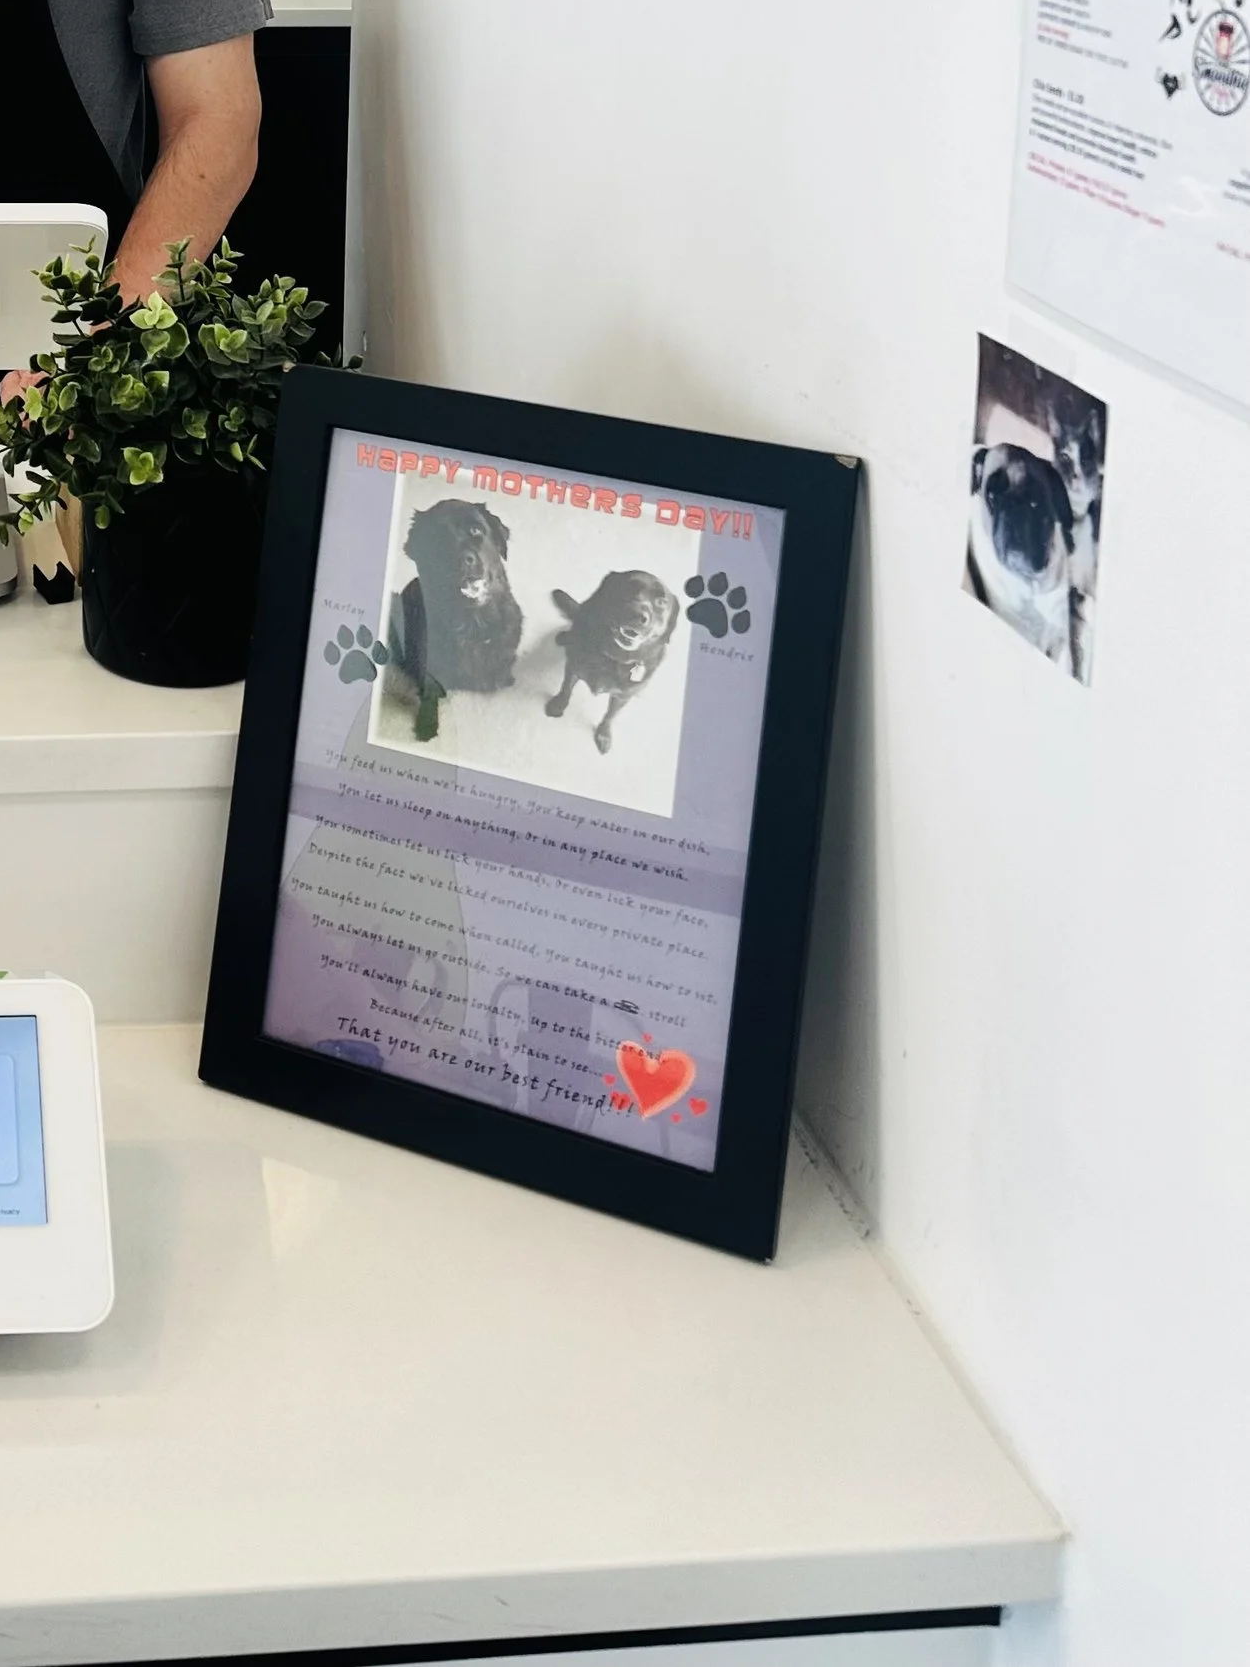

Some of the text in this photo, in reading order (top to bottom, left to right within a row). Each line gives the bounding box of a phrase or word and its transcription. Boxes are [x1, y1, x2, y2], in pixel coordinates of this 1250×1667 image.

[365, 790, 382, 803] let
[385, 797, 400, 808] us
[403, 800, 432, 820] sleep
[436, 810, 451, 822] on
[525, 831, 542, 844] Or
[542, 835, 556, 847] in
[560, 841, 587, 860] any
[591, 848, 629, 869] place
[632, 860, 649, 872] we
[654, 862, 689, 883] wish.
[337, 1016, 382, 1043] That
[388, 1034, 421, 1057] you
[428, 1049, 457, 1065] are
[464, 1058, 496, 1076] our
[501, 1062, 540, 1091] best
